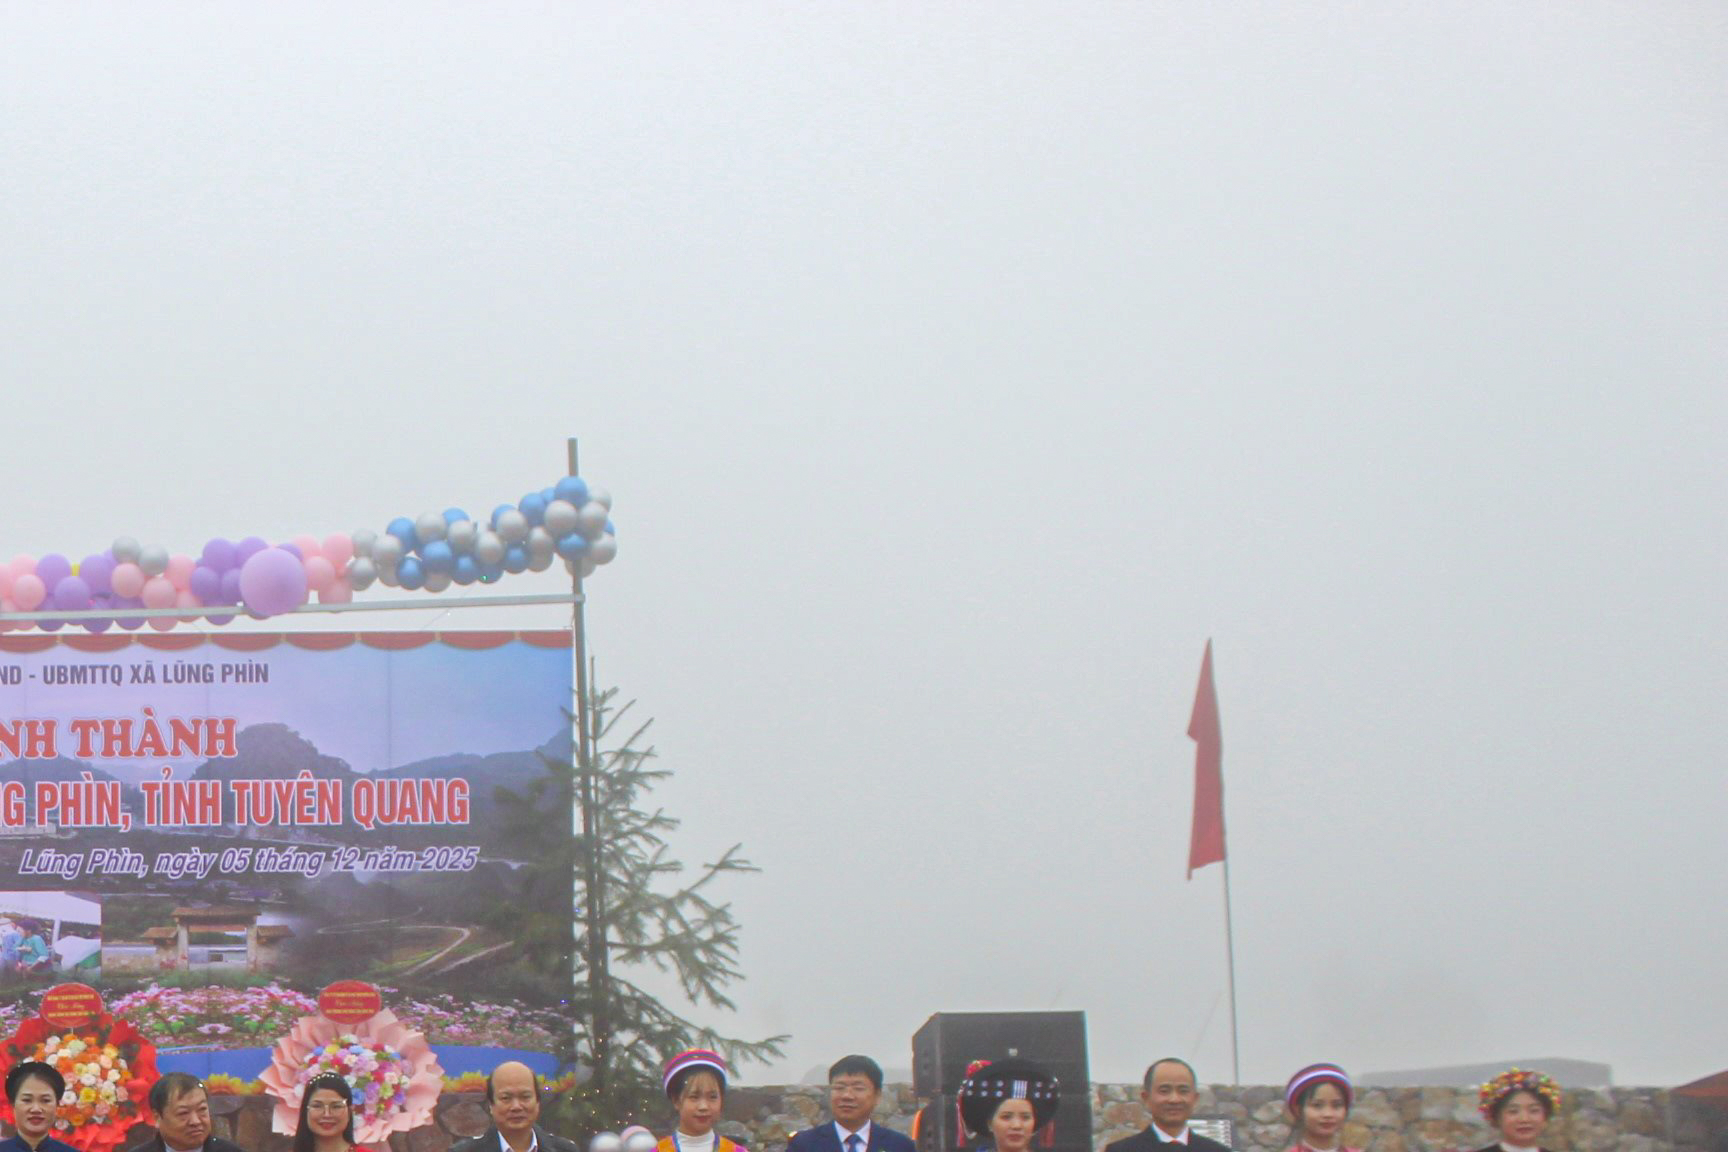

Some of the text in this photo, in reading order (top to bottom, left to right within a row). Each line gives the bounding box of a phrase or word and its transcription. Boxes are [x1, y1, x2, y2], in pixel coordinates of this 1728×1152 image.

[43, 664, 123, 686] UBMTTQ
[130, 660, 156, 684] XÃ
[163, 660, 214, 684] LŨNG
[221, 659, 269, 684] PHÌN
[69, 705, 238, 759] THÀNH
[34, 772, 132, 833] PHÌN,
[141, 767, 222, 826] TỈNH
[230, 771, 342, 826] TUYÊN
[351, 778, 470, 831] QUANG
[18, 845, 480, 880] Lũng Phìn, ngày 05 tháng 12 năm 2025
